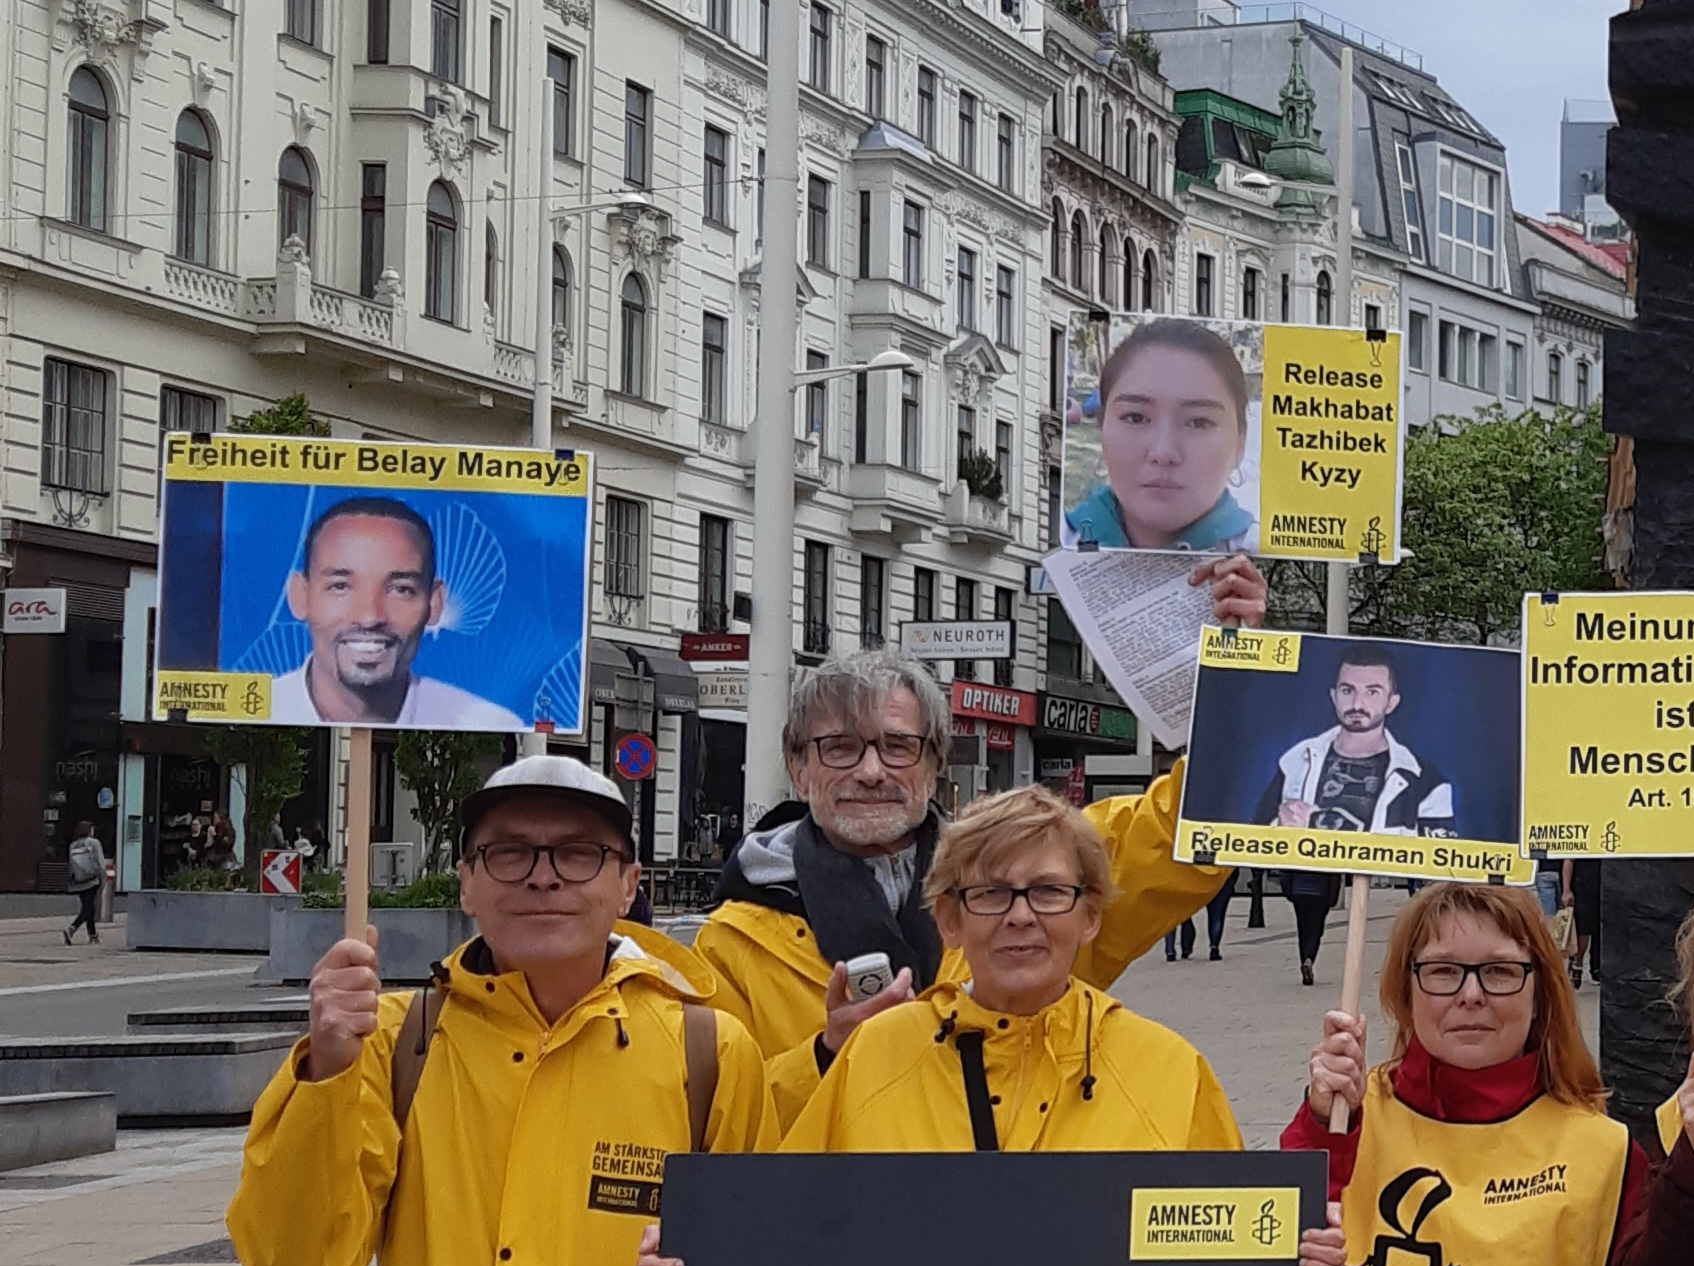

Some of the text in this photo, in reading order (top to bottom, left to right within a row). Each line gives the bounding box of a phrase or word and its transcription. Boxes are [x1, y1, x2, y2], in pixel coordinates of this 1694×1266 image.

[1284, 363, 1383, 389] Release
[1272, 395, 1394, 423] Makhabat
[1276, 427, 1387, 454] Tazhibek
[167, 440, 581, 485] Freiheit für Belay Manaye
[1301, 460, 1361, 488] Kyzy
[1271, 515, 1347, 536] AMNESTY
[1270, 535, 1346, 550] INTERNATIONAL
[932, 629, 1005, 643] NEUROTH
[963, 688, 1021, 716] OPTIKER
[1046, 698, 1089, 734] carla
[1628, 788, 1671, 807] Art.
[1529, 825, 1589, 840] AMNESTY
[1191, 831, 1512, 873] Release Qahraman Shukri
[595, 1141, 610, 1155] AM
[1484, 1165, 1567, 1195] AMNESTY
[1484, 1181, 1567, 1205] INTERNATIONAL
[1147, 1204, 1237, 1226] AMNESTY
[1146, 1230, 1235, 1244] INTERNATIONAL
